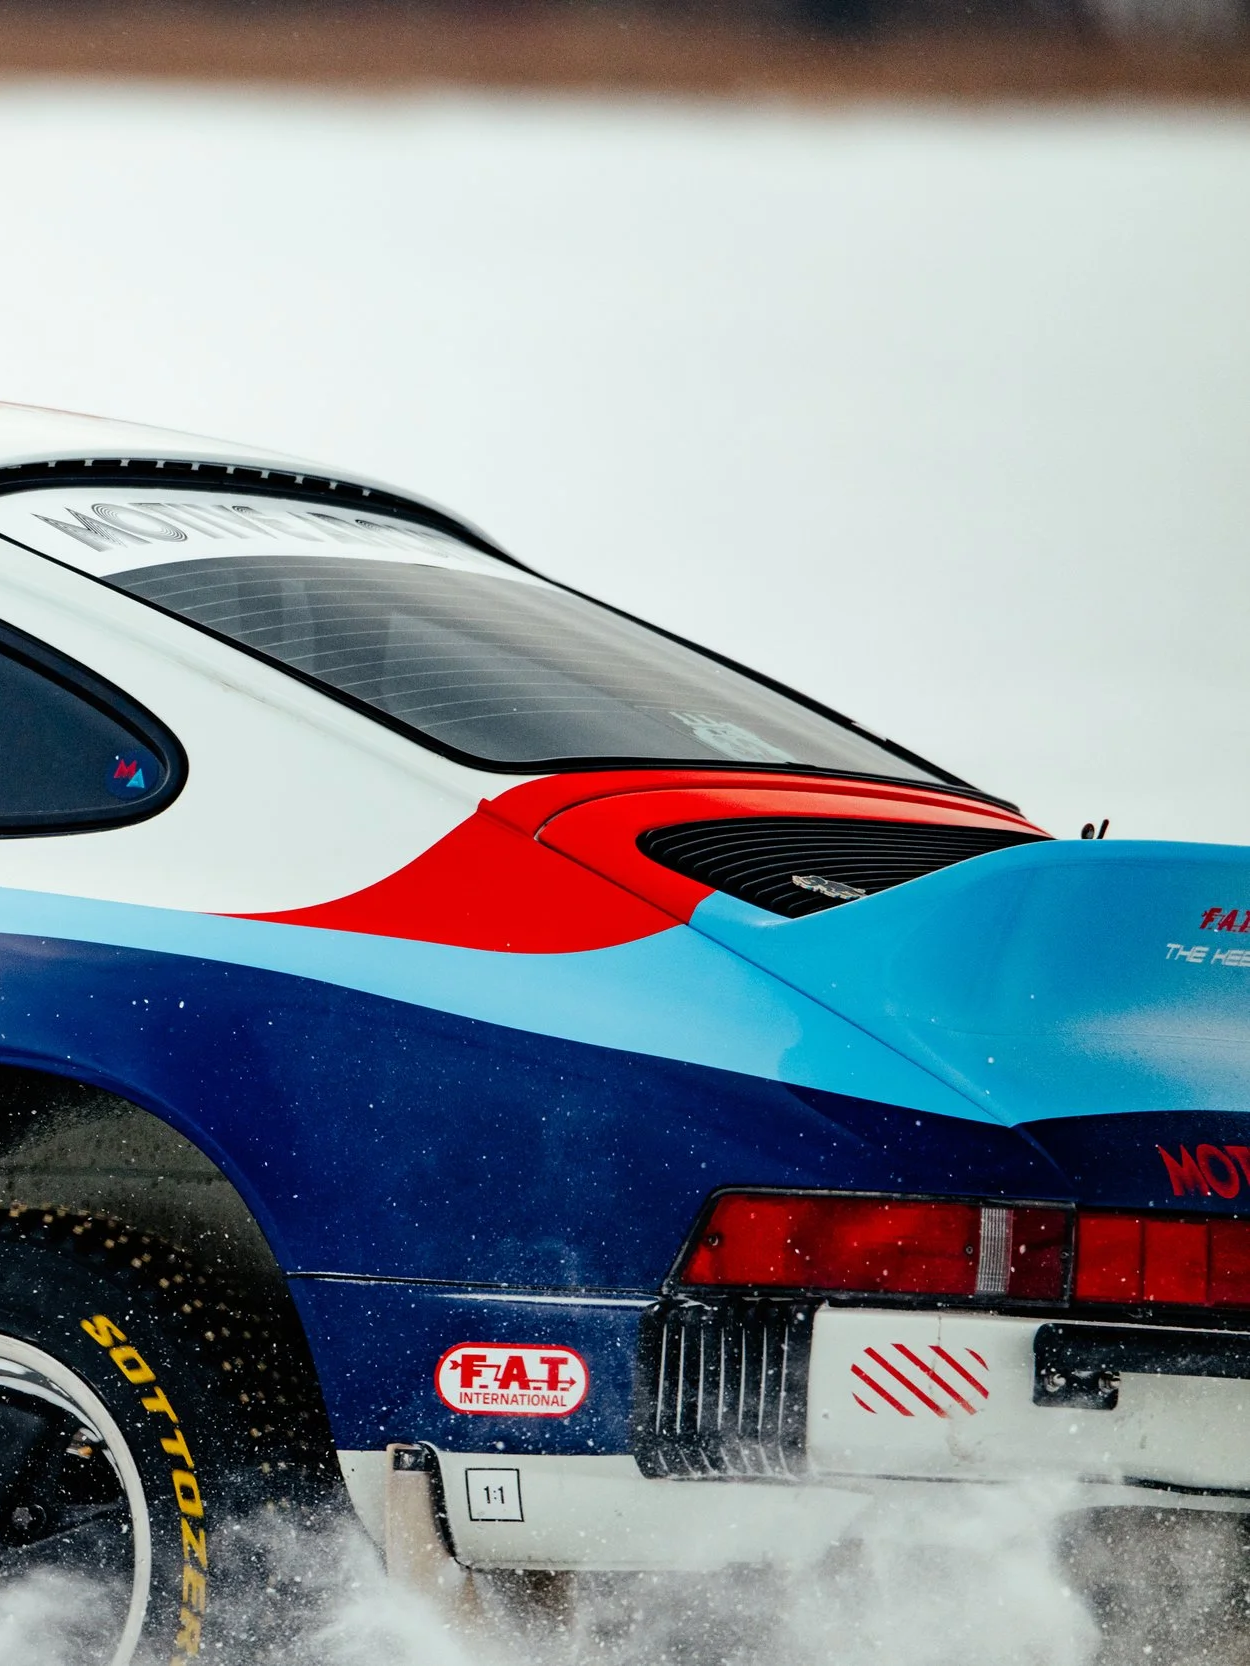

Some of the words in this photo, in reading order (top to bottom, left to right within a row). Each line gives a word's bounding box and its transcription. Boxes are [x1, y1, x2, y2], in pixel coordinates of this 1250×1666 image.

[1166, 943, 1209, 963] THE
[458, 1391, 568, 1407] INTERNATIONAL
[80, 1314, 208, 1666] SOTTOZER
[483, 1485, 505, 1505] 1:1
